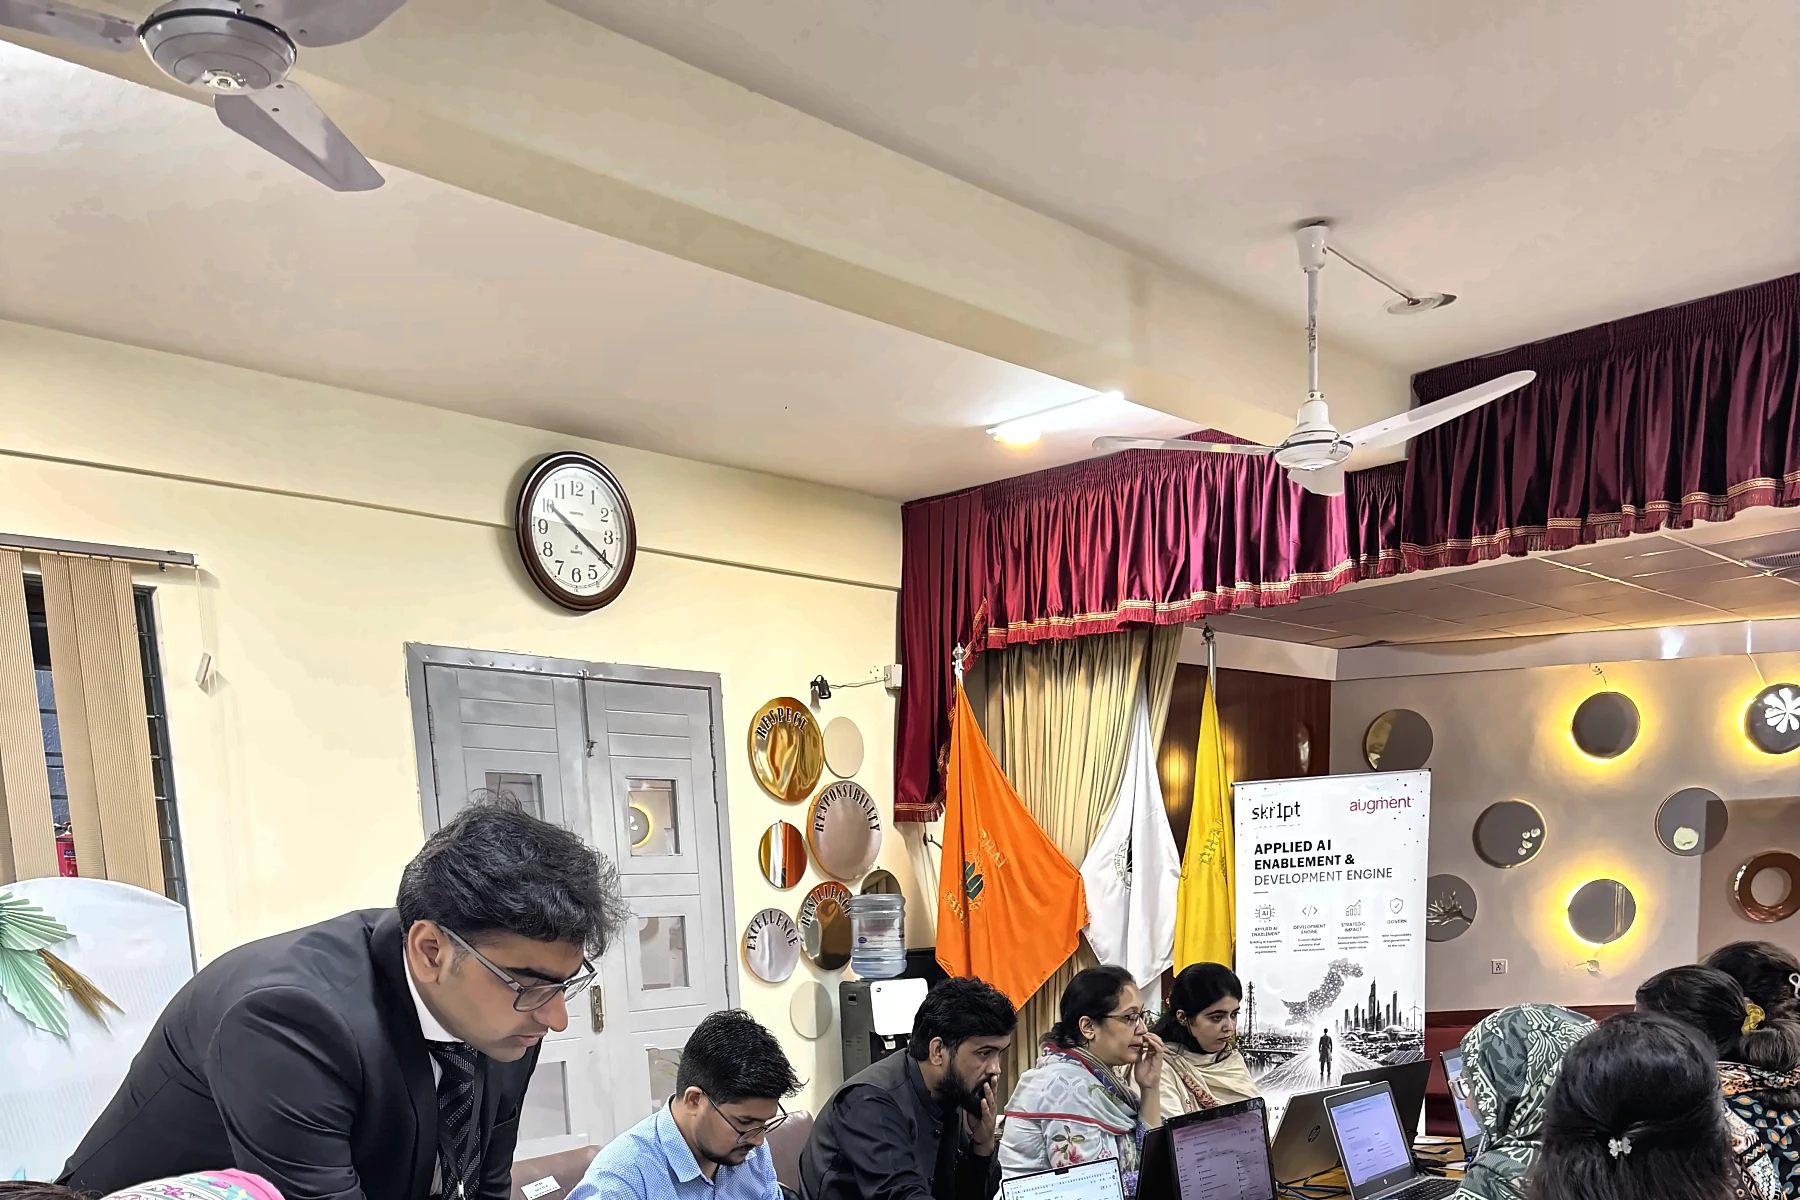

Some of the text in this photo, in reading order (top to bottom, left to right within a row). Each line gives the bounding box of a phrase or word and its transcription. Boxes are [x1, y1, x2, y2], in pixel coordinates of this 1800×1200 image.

[554, 483, 565, 499] 11
[570, 480, 584, 497] 12
[542, 497, 555, 514] 10
[591, 490, 596, 505] 1
[600, 507, 610, 522] 2
[538, 519, 549, 534] 9
[604, 530, 614, 545] 3
[543, 541, 553, 557] 8
[554, 559, 564, 575] 7
[571, 567, 582, 583] 6
[588, 565, 598, 580] 5
[755, 707, 808, 740] RESPECT
[814, 784, 881, 832] RESPONSIBILITY
[1350, 796, 1411, 814] augment
[1254, 839, 1331, 855] APPLIED AI
[1254, 854, 1355, 870] ENABLEMENT &
[1254, 867, 1393, 886] DEVELOPMENT ENGINE
[746, 910, 799, 951] EXCELLENCE
